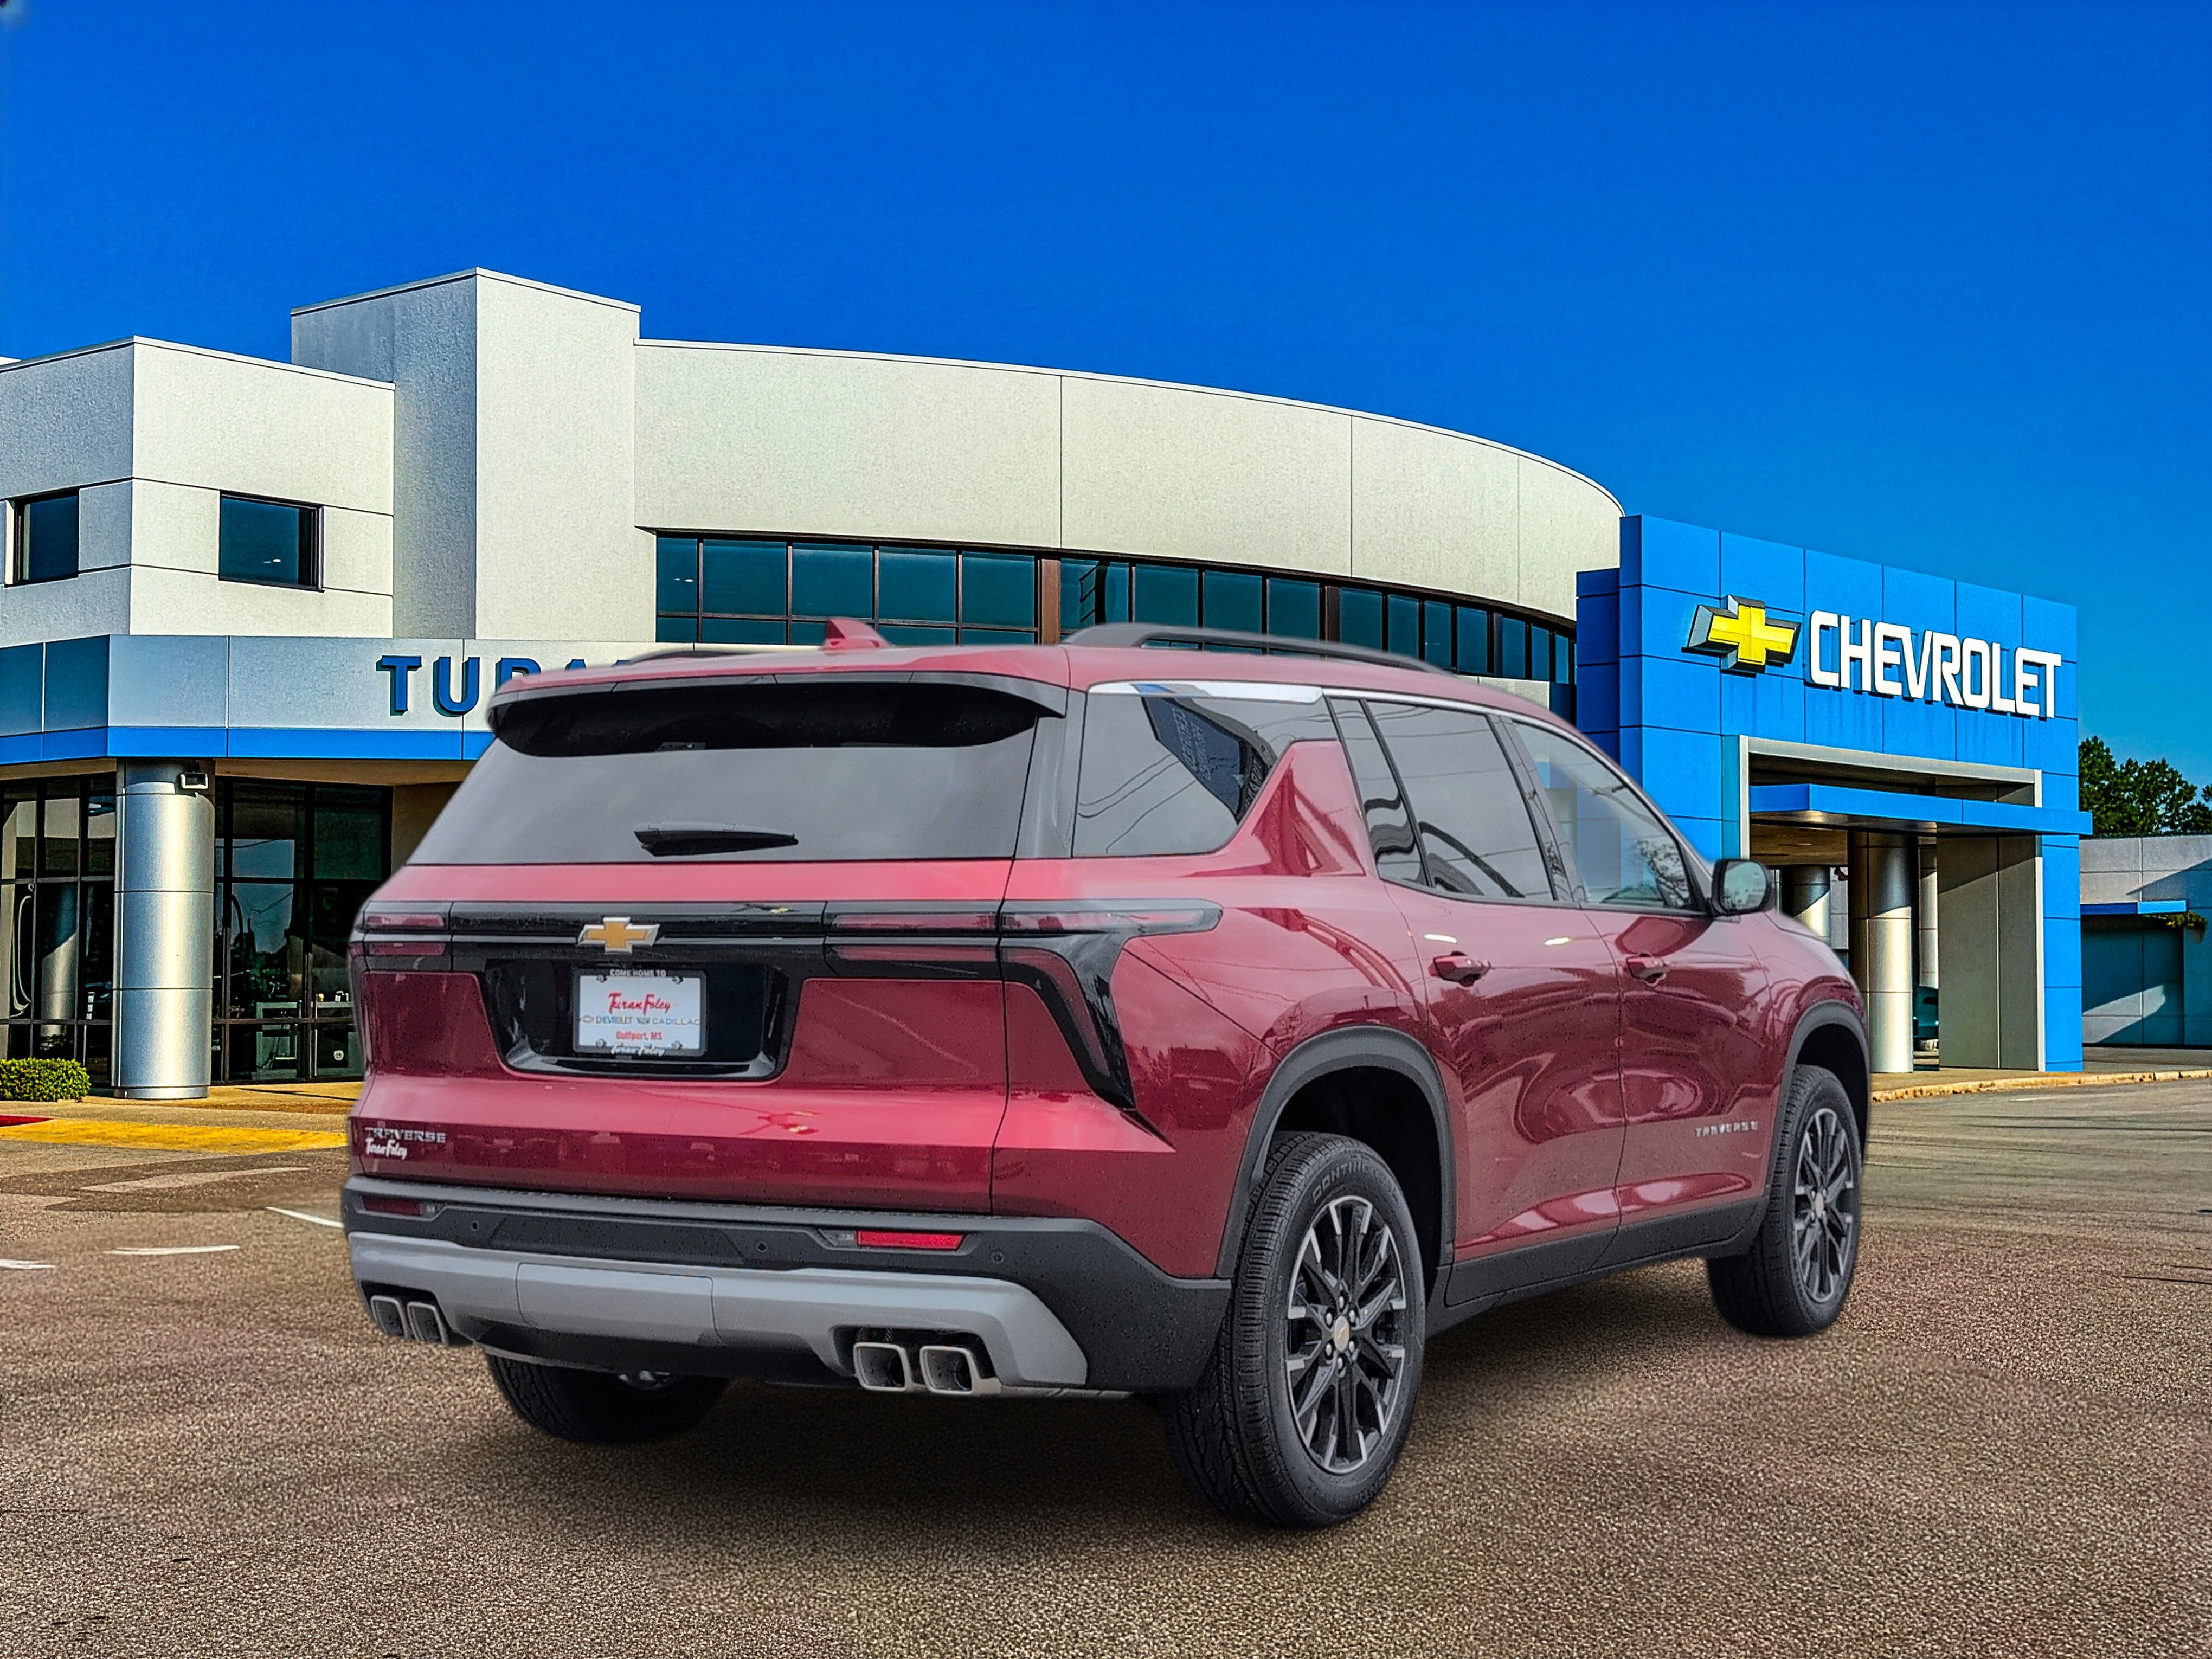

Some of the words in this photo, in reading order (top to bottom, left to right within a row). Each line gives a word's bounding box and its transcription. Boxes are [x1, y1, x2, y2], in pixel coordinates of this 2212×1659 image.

[1809, 610, 2062, 718] CHEVROLET
[655, 969, 667, 978] TO
[650, 1031, 663, 1040] MS
[365, 1127, 446, 1143] TRAVERSE
[1695, 1121, 1759, 1137] TRAVERSE
